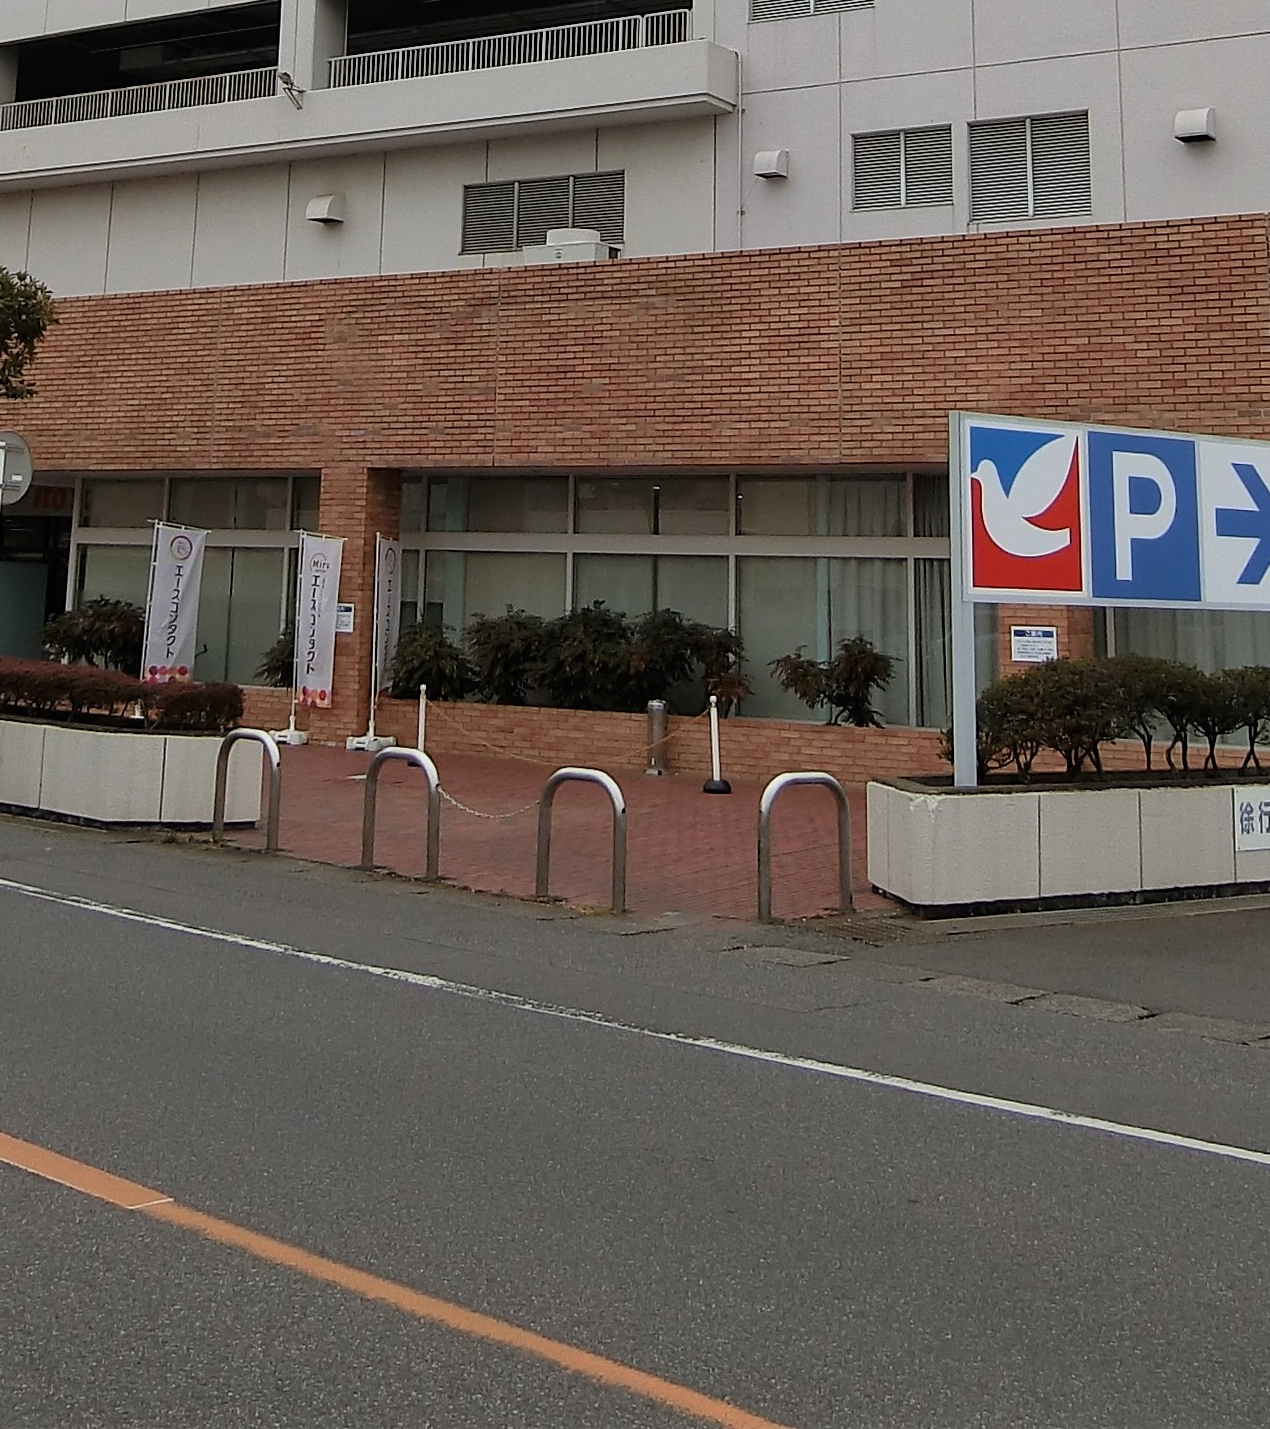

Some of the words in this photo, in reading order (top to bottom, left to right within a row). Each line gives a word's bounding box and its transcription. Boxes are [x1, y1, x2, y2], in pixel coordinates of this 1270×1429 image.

[1112, 451, 1177, 581] P
[166, 565, 184, 659] エースコンタクト
[306, 574, 321, 675] エースコンタクト
